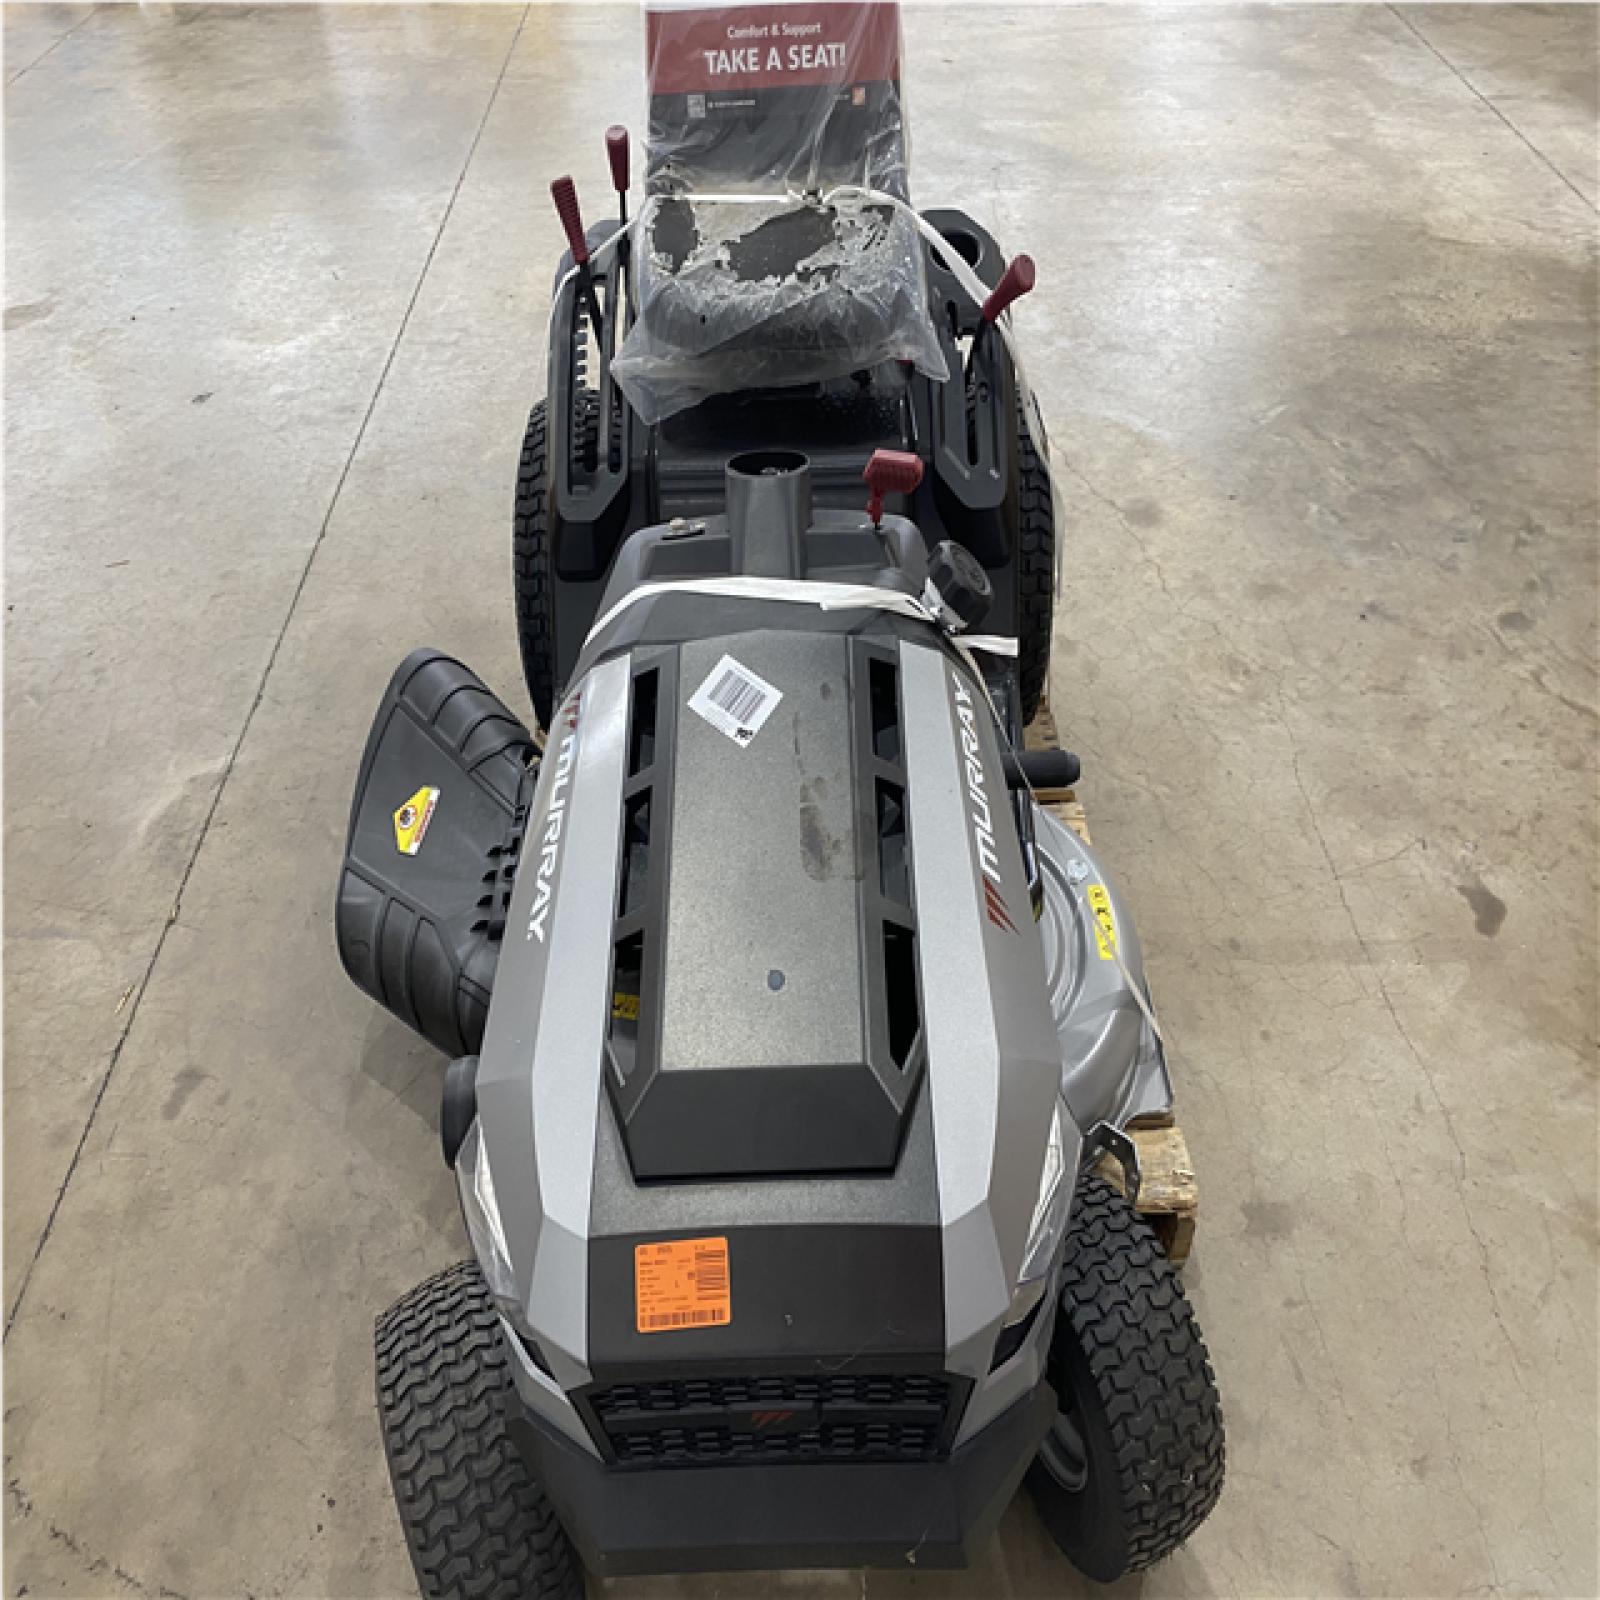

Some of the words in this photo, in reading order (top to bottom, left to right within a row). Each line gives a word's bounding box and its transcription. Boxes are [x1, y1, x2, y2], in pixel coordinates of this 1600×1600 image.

[704, 48, 760, 75] TAKE
[766, 47, 781, 71] A
[788, 42, 846, 70] SEAT!
[727, 25, 768, 39] Comfort
[771, 24, 780, 37] &
[782, 22, 821, 37] Support
[951, 669, 1001, 883] MURRAY
[527, 734, 576, 943] MURRAY
